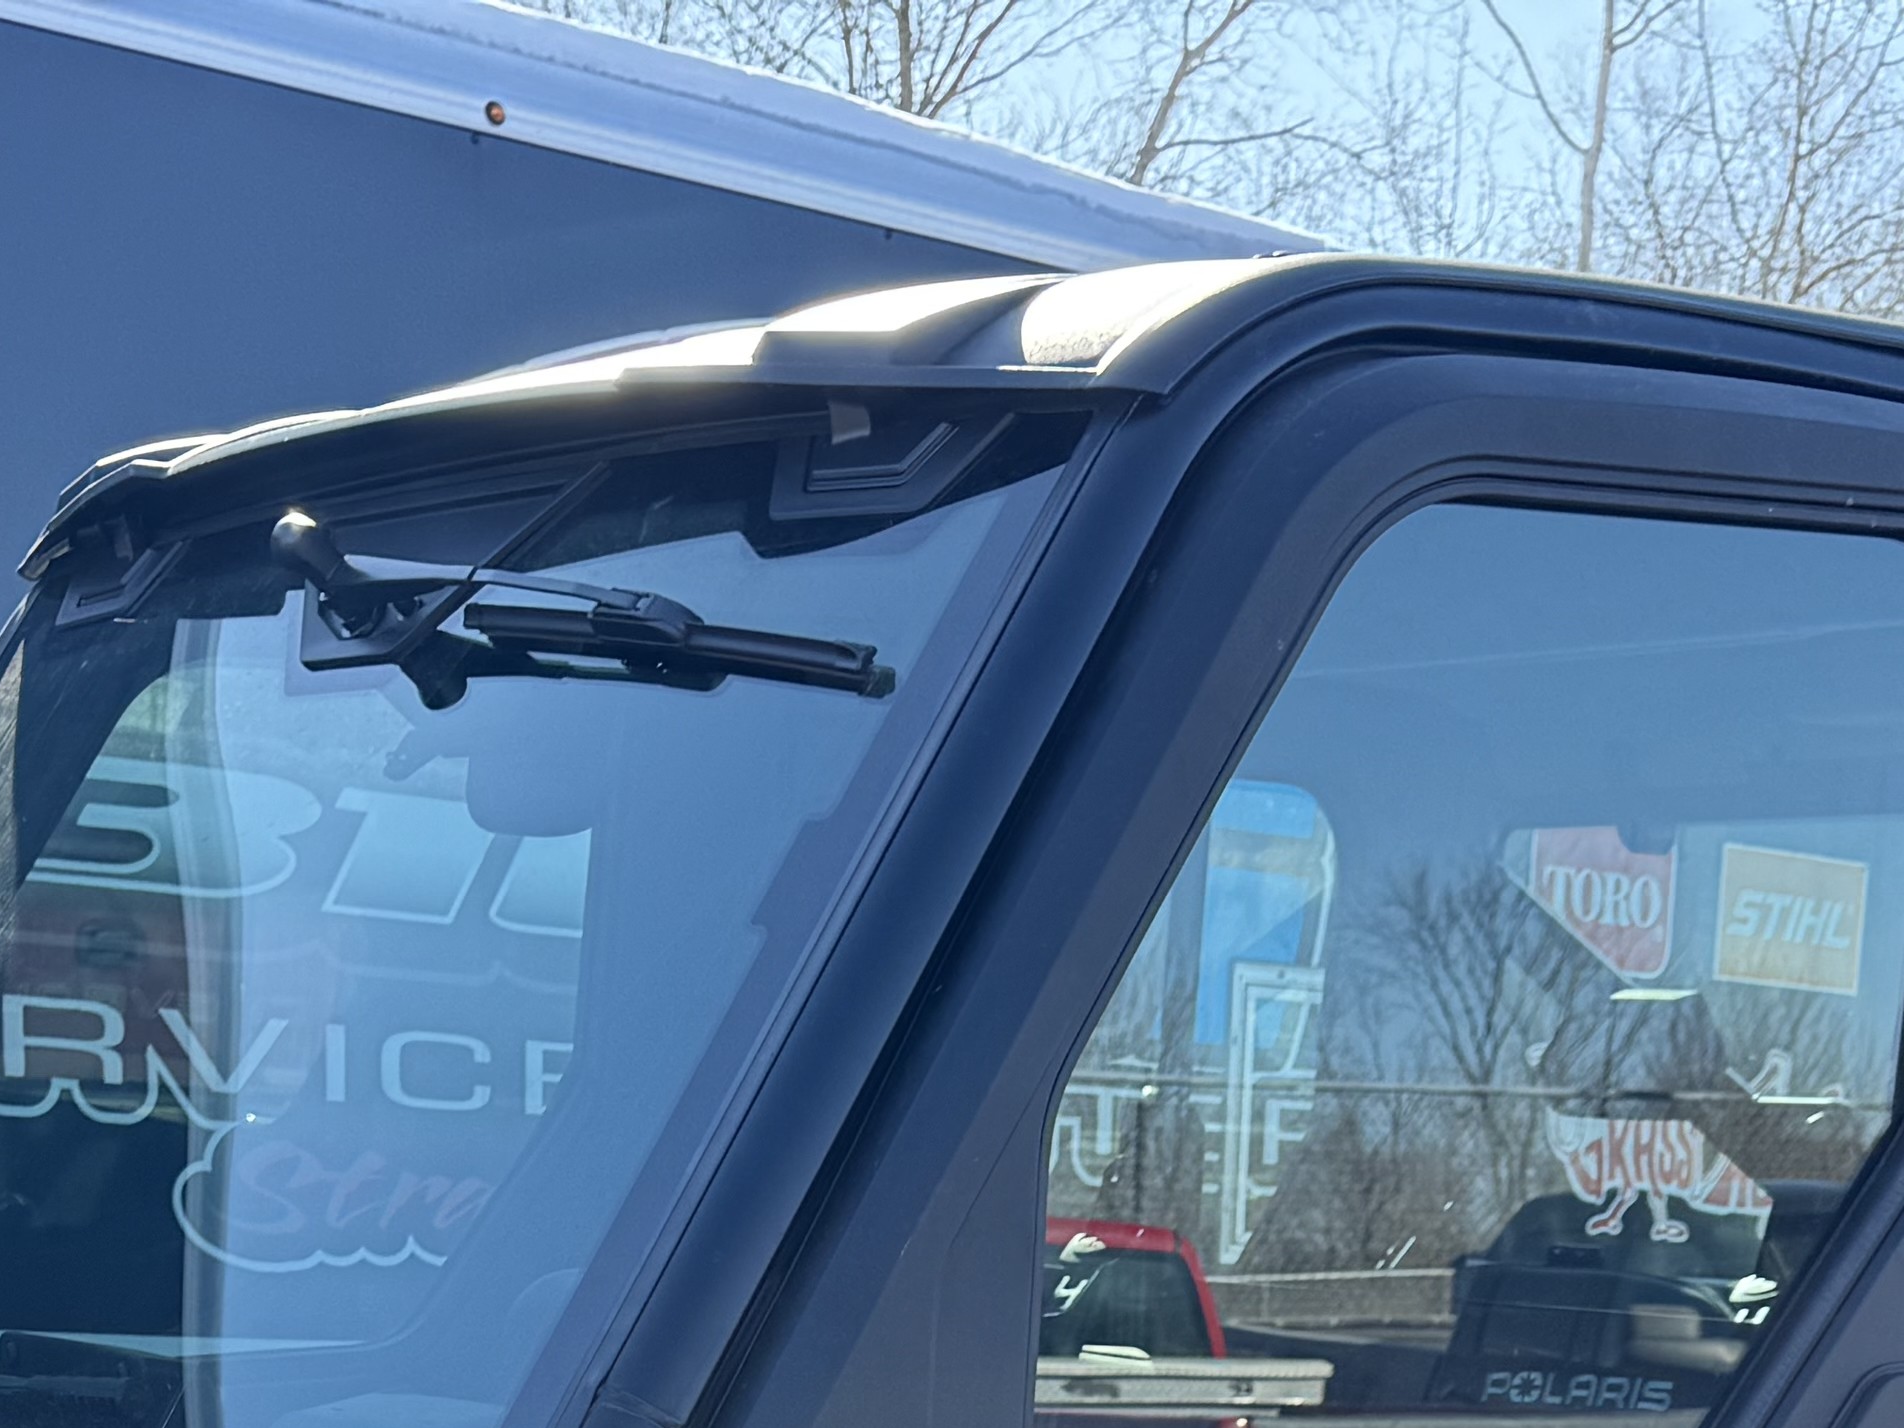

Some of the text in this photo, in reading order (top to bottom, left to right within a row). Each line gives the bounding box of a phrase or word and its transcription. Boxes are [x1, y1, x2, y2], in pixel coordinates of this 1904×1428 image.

[1542, 864, 1664, 930] TORO
[1726, 888, 1853, 950] STIHL
[1480, 1371, 1674, 1412] POLARIS
